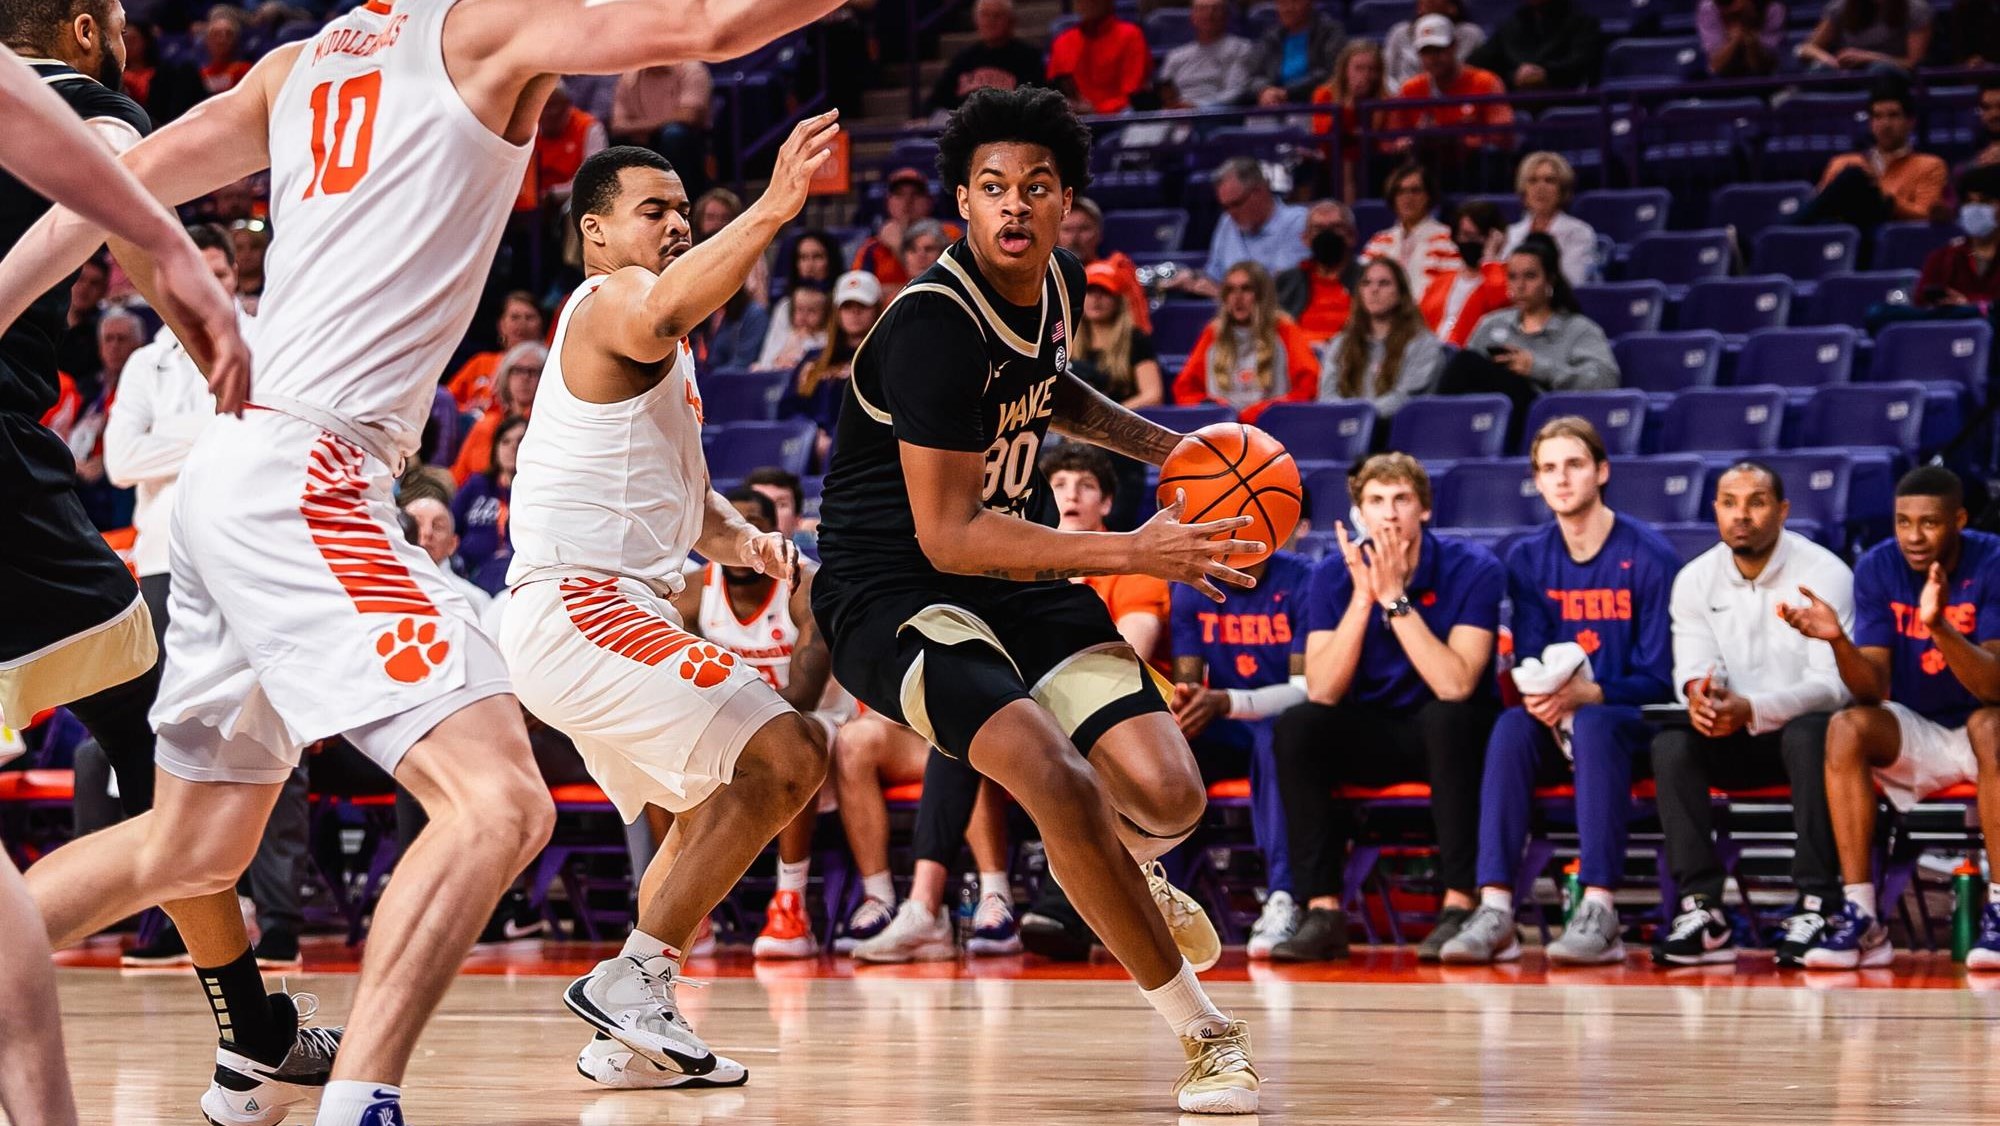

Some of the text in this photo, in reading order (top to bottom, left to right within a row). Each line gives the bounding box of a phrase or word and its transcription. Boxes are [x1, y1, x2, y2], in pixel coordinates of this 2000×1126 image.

[301, 69, 383, 201] 10
[981, 431, 1039, 502] 30
[1196, 612, 1292, 645] TIGERS
